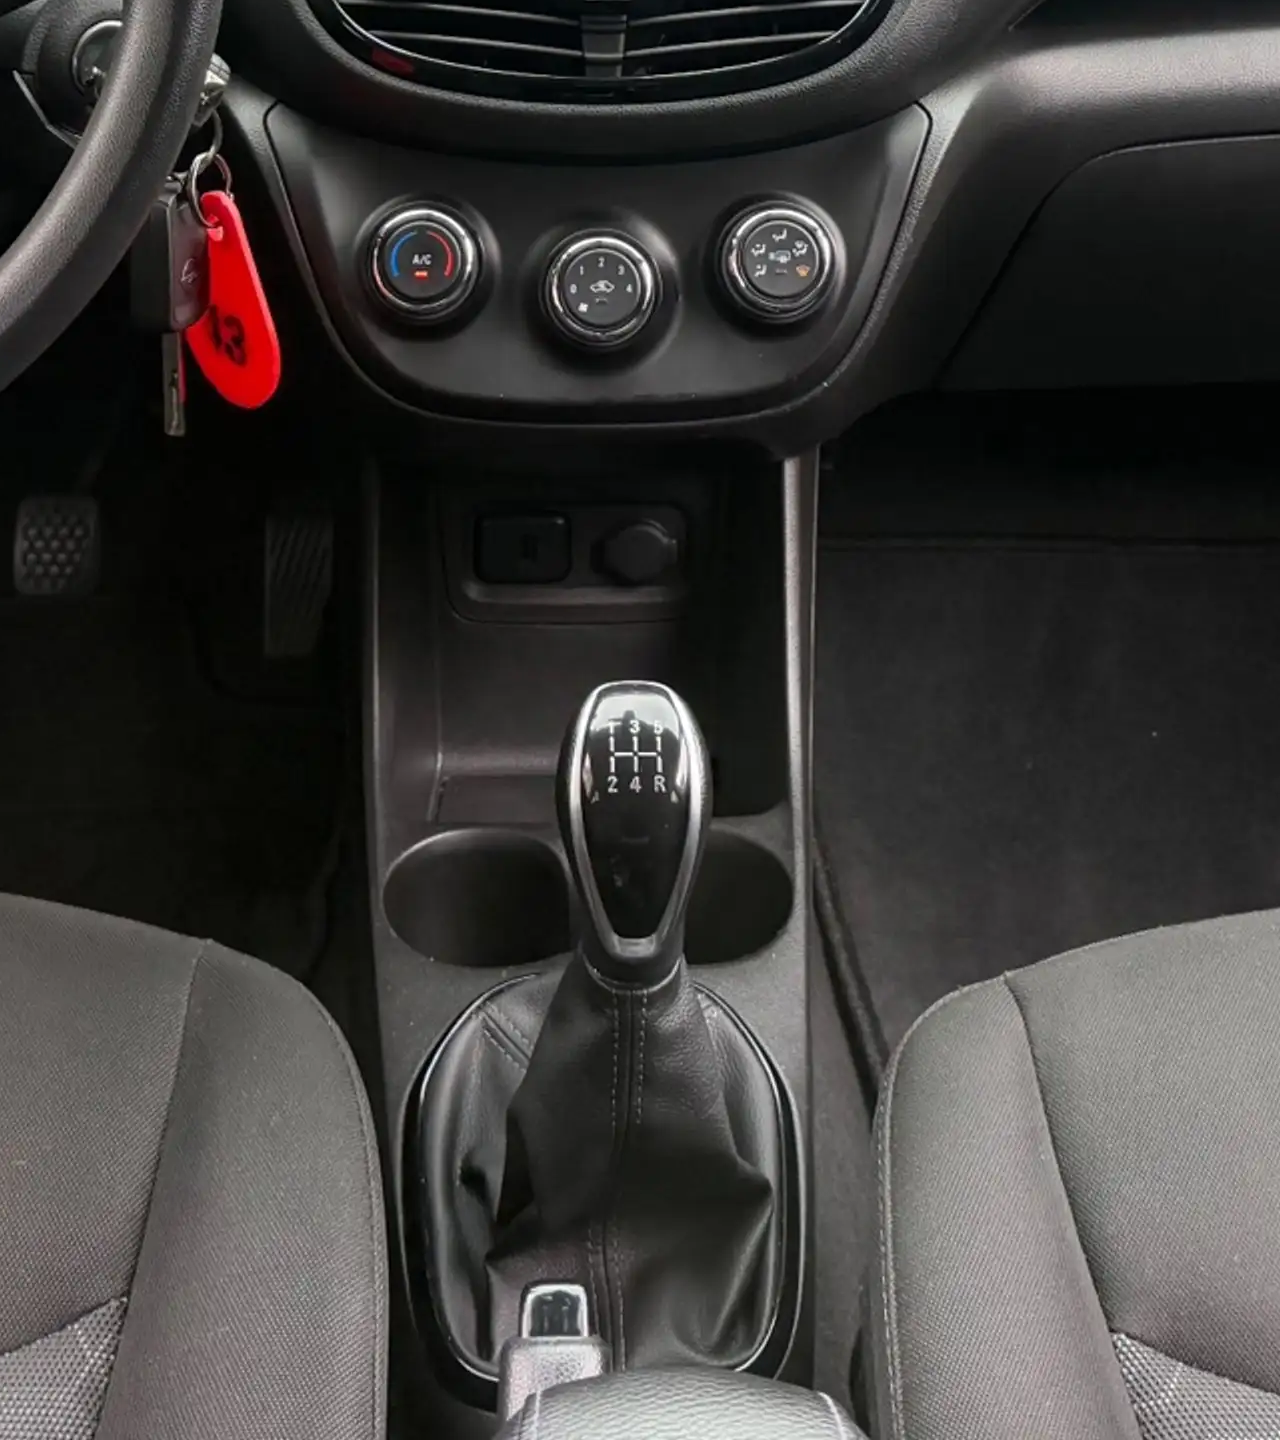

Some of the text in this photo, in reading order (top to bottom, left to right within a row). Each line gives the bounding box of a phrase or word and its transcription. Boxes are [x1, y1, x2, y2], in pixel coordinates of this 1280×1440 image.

[412, 254, 432, 266] A/C
[598, 257, 605, 268] 2
[579, 266, 585, 275] 1
[618, 265, 625, 276] 3
[570, 284, 577, 294] 0
[626, 283, 633, 293] 4
[629, 720, 641, 734] 3
[653, 720, 664, 735] 5
[607, 774, 667, 794] 2 4 R
